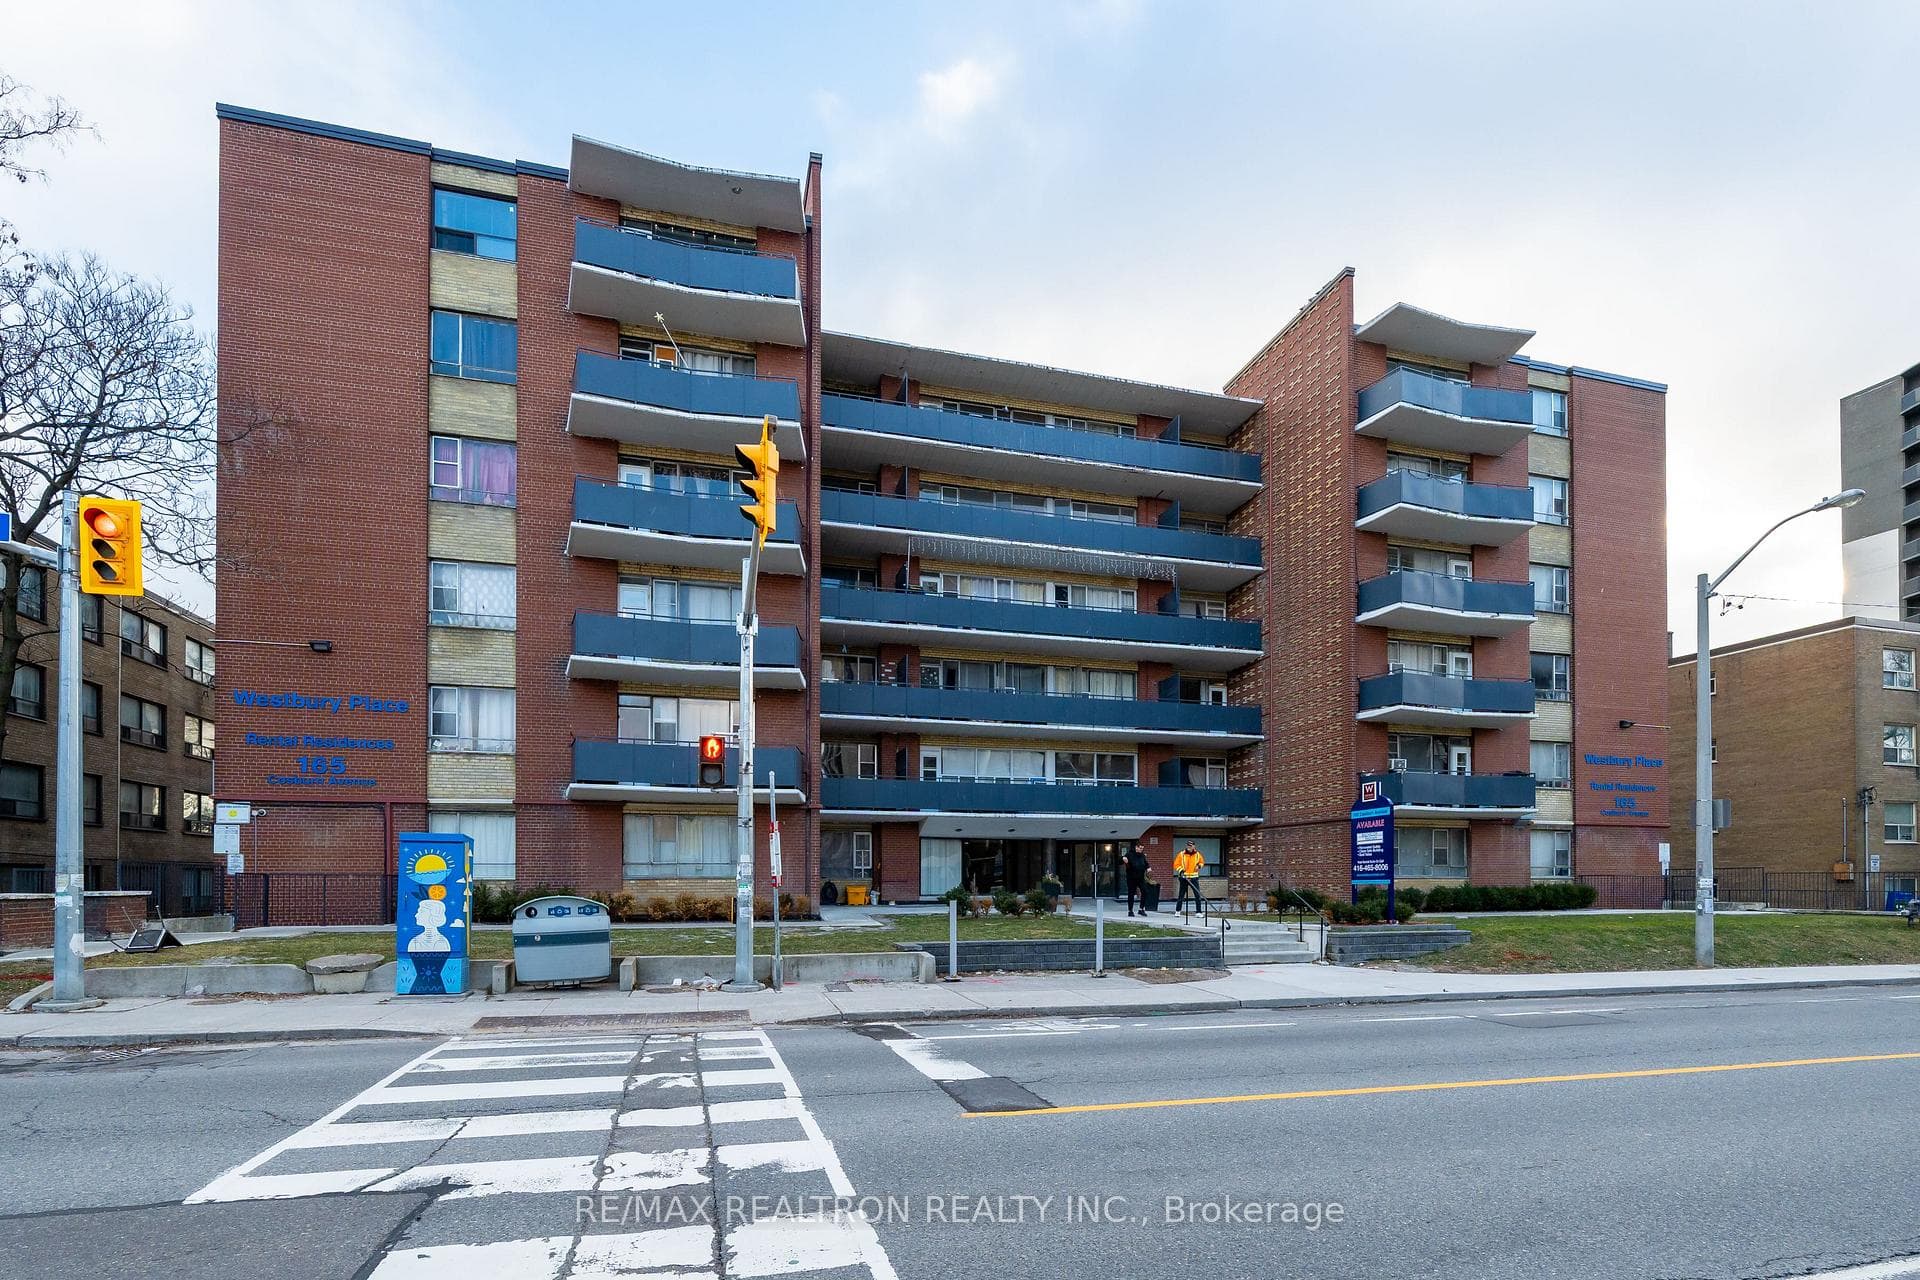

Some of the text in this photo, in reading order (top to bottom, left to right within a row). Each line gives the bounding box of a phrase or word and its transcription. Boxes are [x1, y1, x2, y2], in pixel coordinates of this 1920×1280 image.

[233, 688, 410, 714] Westbury Place
[245, 732, 395, 750] Rental Residences
[296, 756, 347, 775] 165
[1584, 753, 1633, 768] Westbury
[1365, 784, 1374, 793] W
[1356, 819, 1385, 829] AVAILABLE
